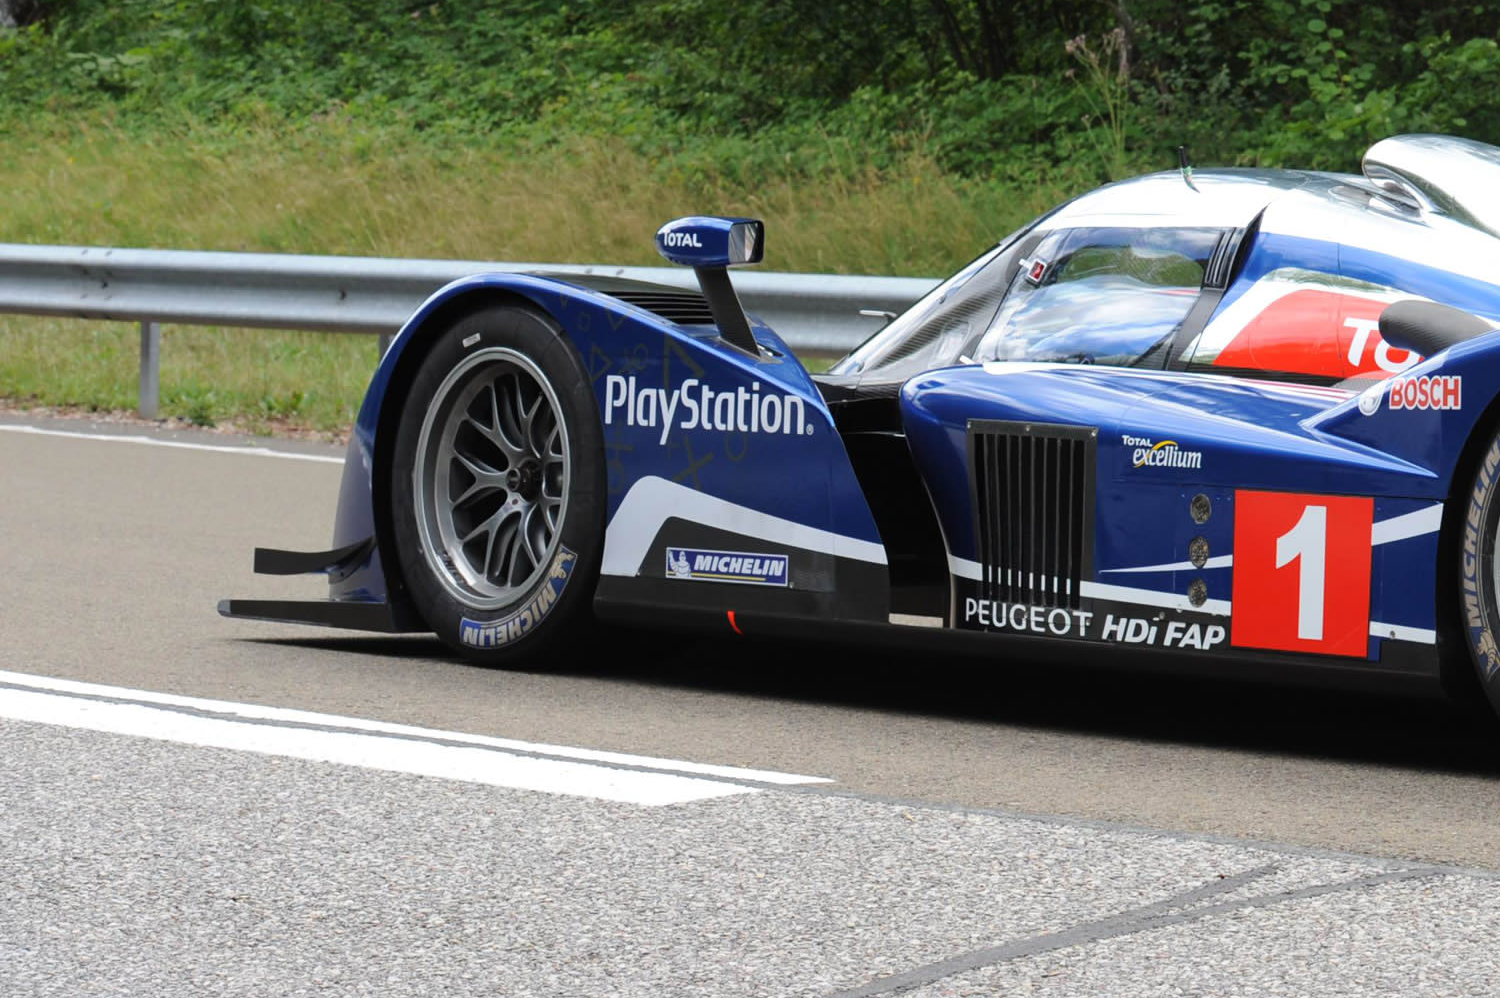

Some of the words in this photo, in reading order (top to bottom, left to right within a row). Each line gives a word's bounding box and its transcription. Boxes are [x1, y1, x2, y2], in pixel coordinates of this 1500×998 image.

[664, 231, 703, 248] TOTAL
[1389, 375, 1462, 410] BOSCH
[1132, 445, 1202, 469] excellium
[693, 554, 785, 577] MICHELIN
[1276, 505, 1327, 641] 1
[463, 579, 557, 647] MICHELIN
[965, 597, 1094, 637] PEUGEOT
[1101, 614, 1158, 645] HDi
[1163, 621, 1226, 651] FAP
